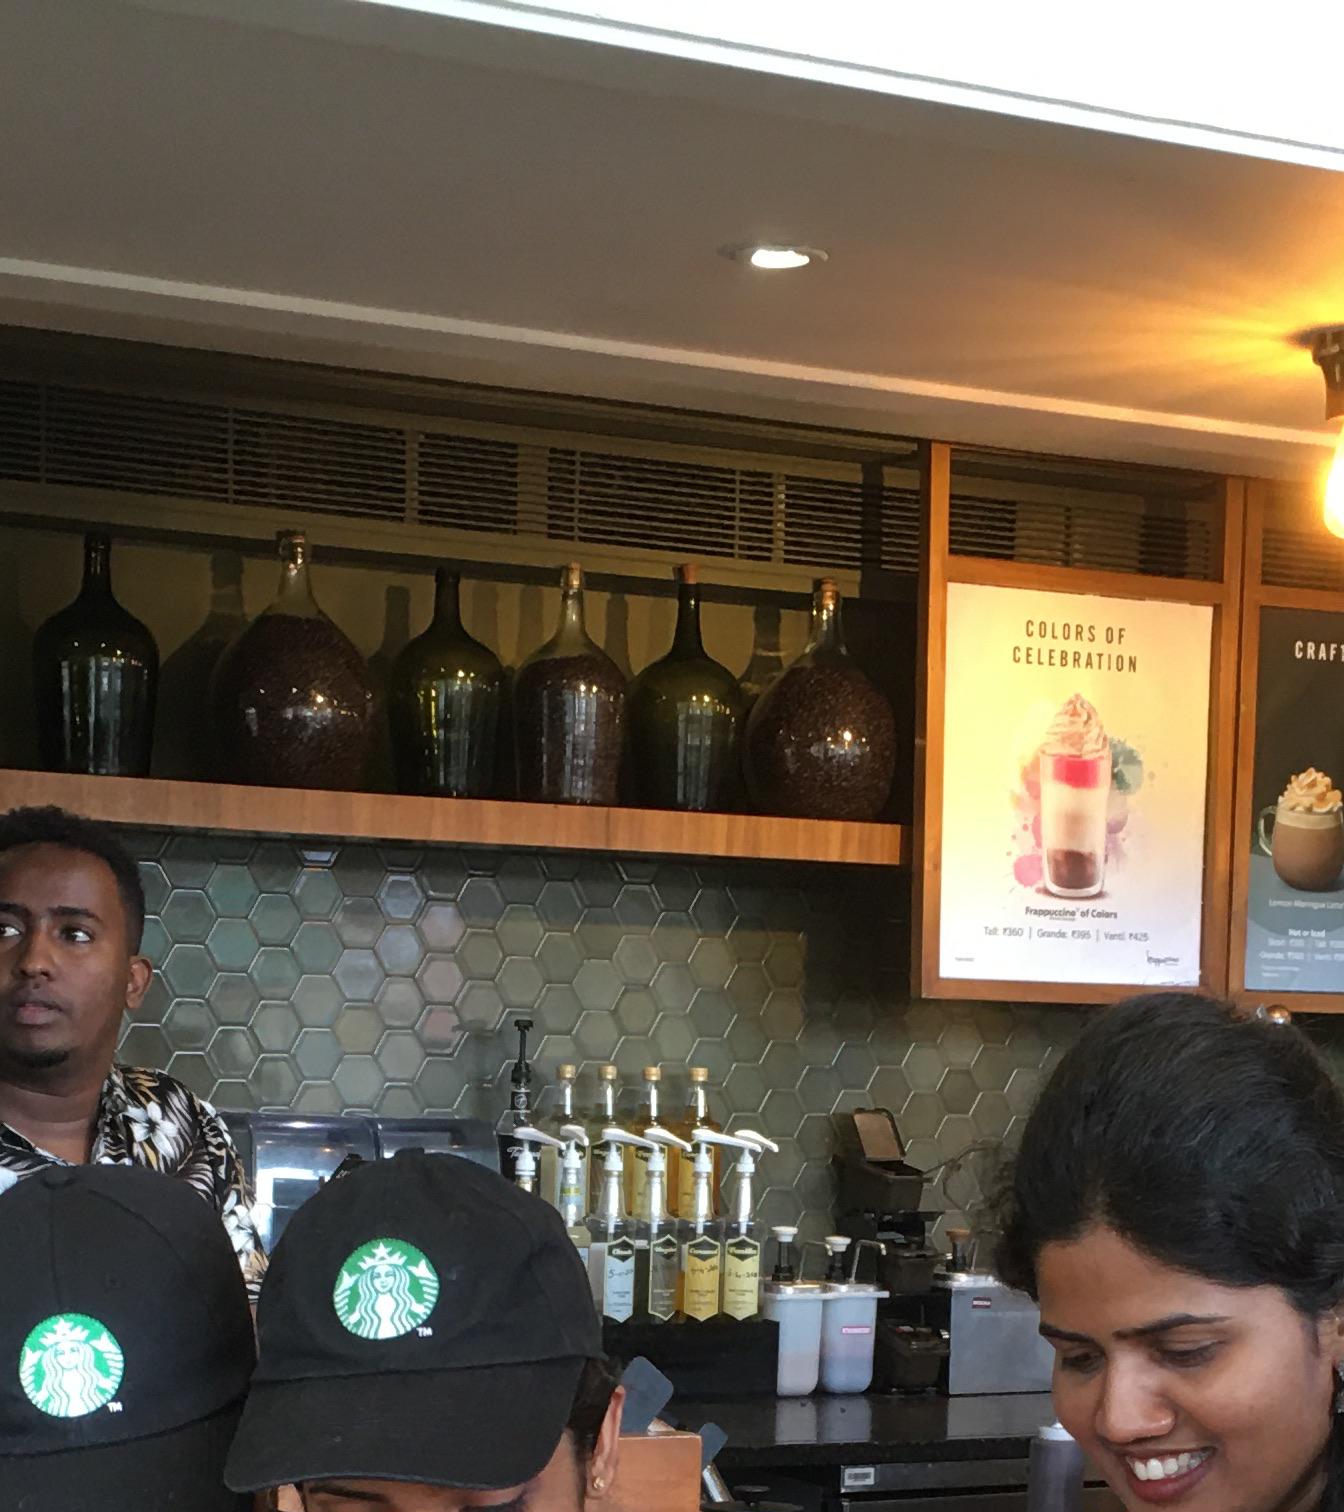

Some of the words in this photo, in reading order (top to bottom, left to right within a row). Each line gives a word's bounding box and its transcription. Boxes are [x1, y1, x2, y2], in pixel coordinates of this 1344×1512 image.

[1026, 619, 1096, 642] COLORS
[1105, 626, 1126, 645] OF
[1012, 645, 1137, 673] CELEBRATION
